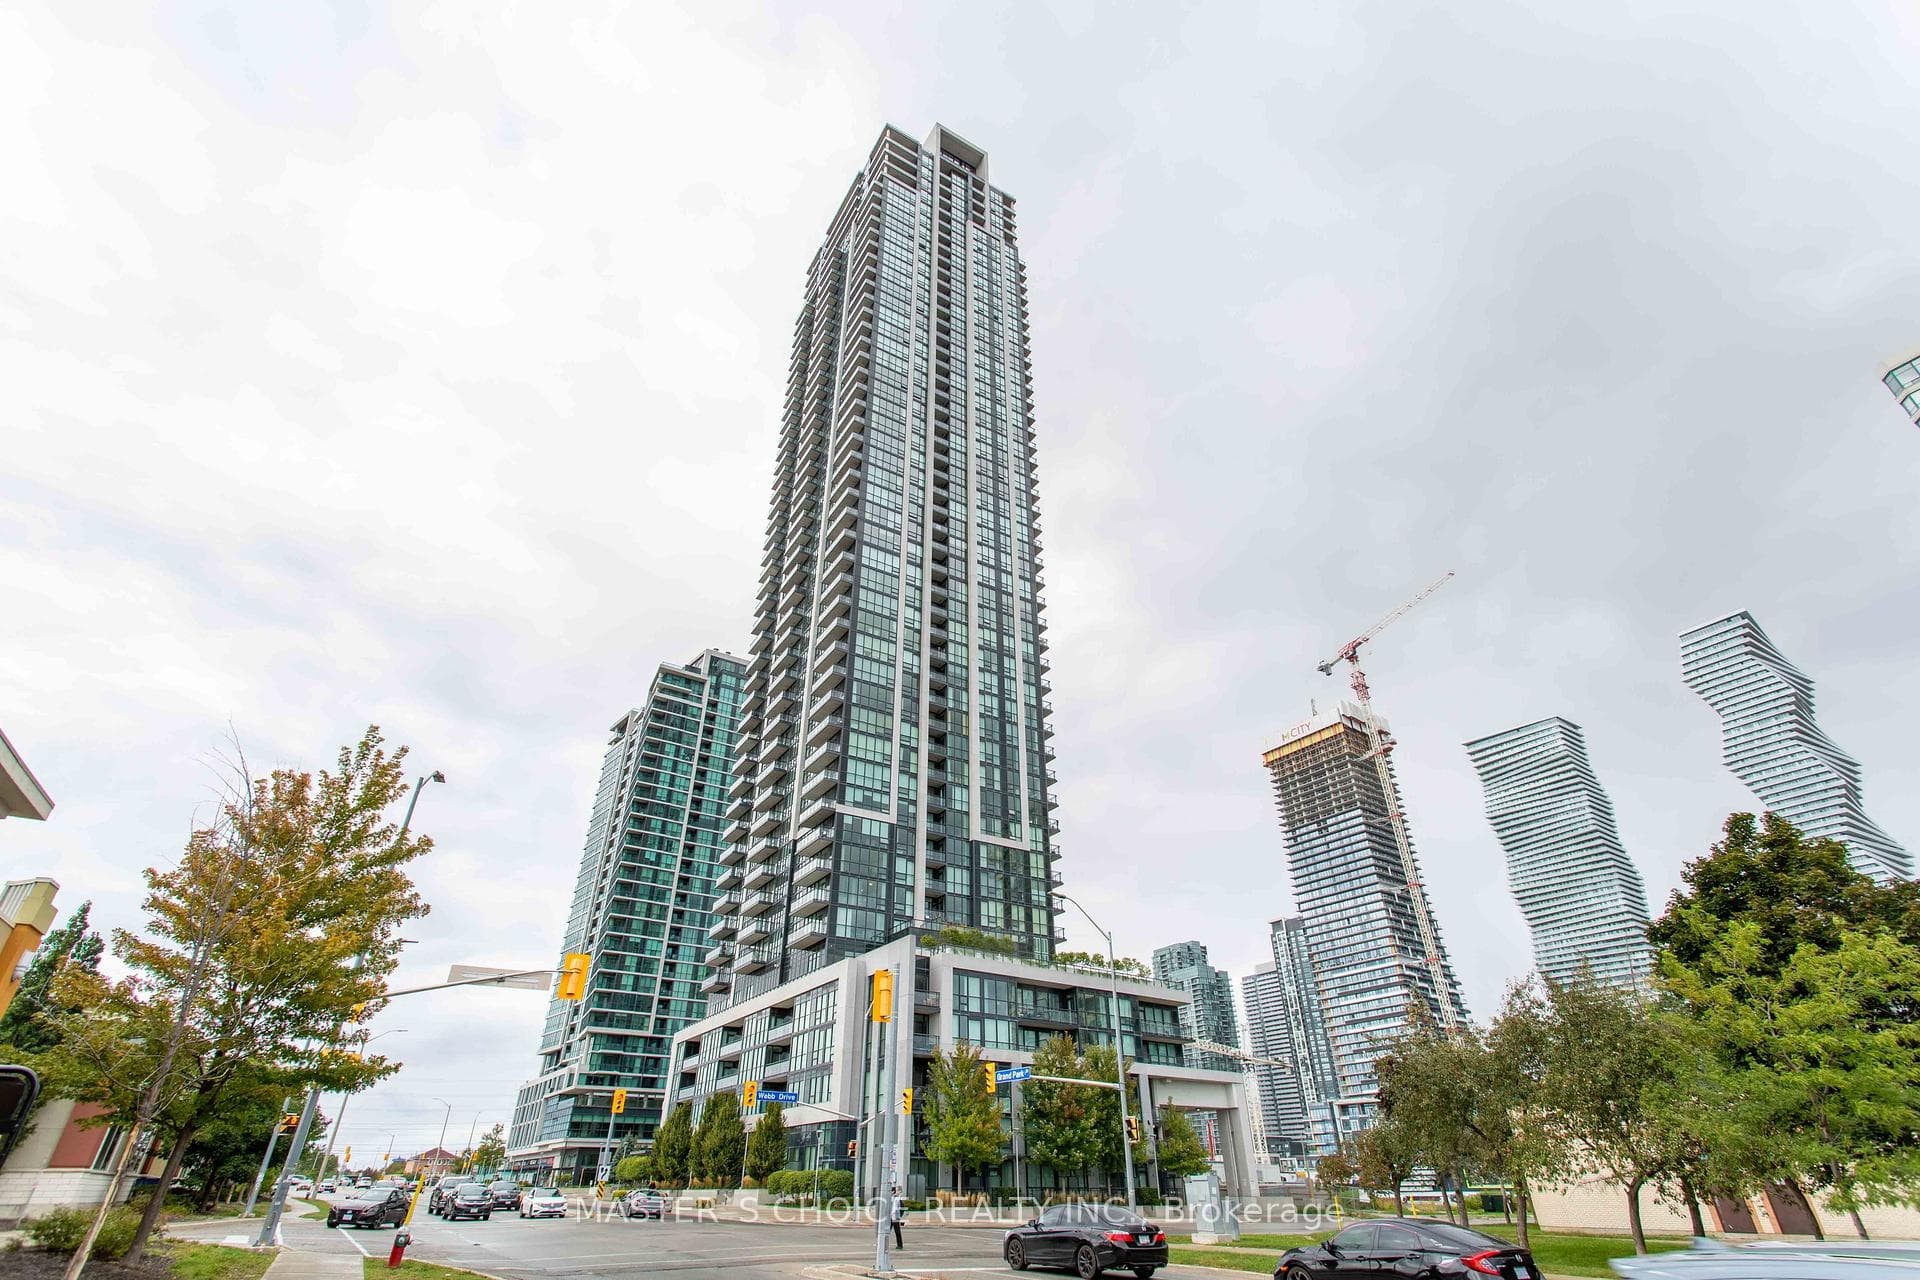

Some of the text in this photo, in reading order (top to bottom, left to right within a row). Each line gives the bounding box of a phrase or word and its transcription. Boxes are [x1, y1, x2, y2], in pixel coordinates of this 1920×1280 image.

[996, 1072, 1012, 1081] Grand
[1012, 1070, 1024, 1079] Park
[758, 1092, 796, 1101] Webb Drive
